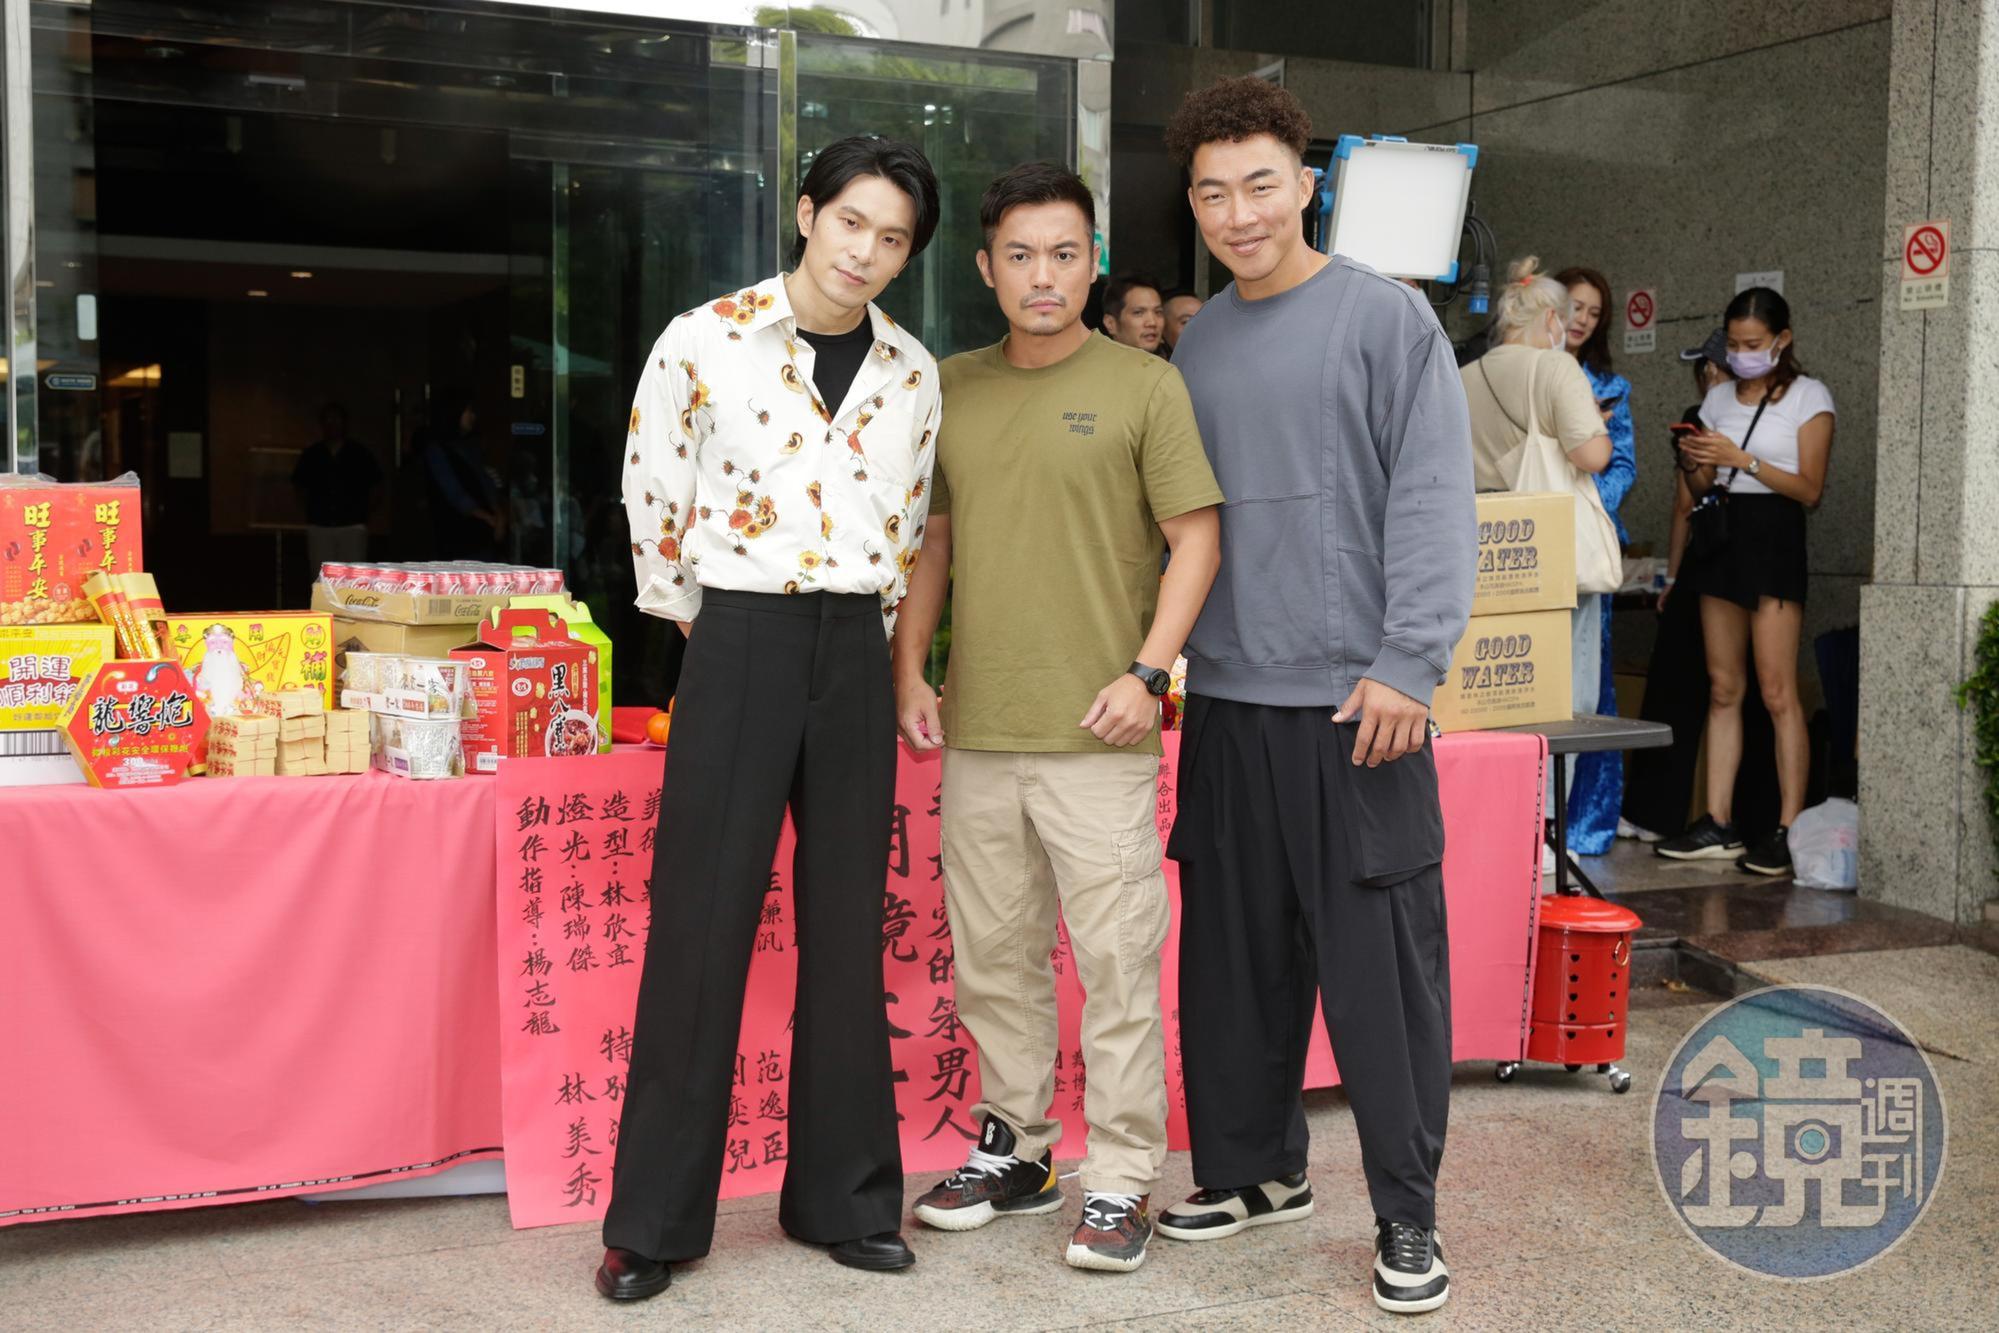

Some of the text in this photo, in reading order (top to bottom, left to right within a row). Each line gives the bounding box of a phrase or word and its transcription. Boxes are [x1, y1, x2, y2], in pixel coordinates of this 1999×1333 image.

[95, 500, 121, 577] 旺事平
[1477, 518, 1535, 544] GOOD
[1477, 546, 1538, 573] ATER
[9, 656, 71, 681] 開運
[1461, 661, 1535, 690] WATER
[1475, 634, 1532, 661] GOOD
[549, 664, 571, 751] 黑八寶
[515, 795, 560, 1036] 動作指導：楊志龍
[556, 793, 601, 973] 燈光：陳瑞傑
[599, 790, 636, 968] 造型：林欣宜
[554, 1072, 603, 1208] 林美秀
[757, 1050, 789, 1165] 范逸臣
